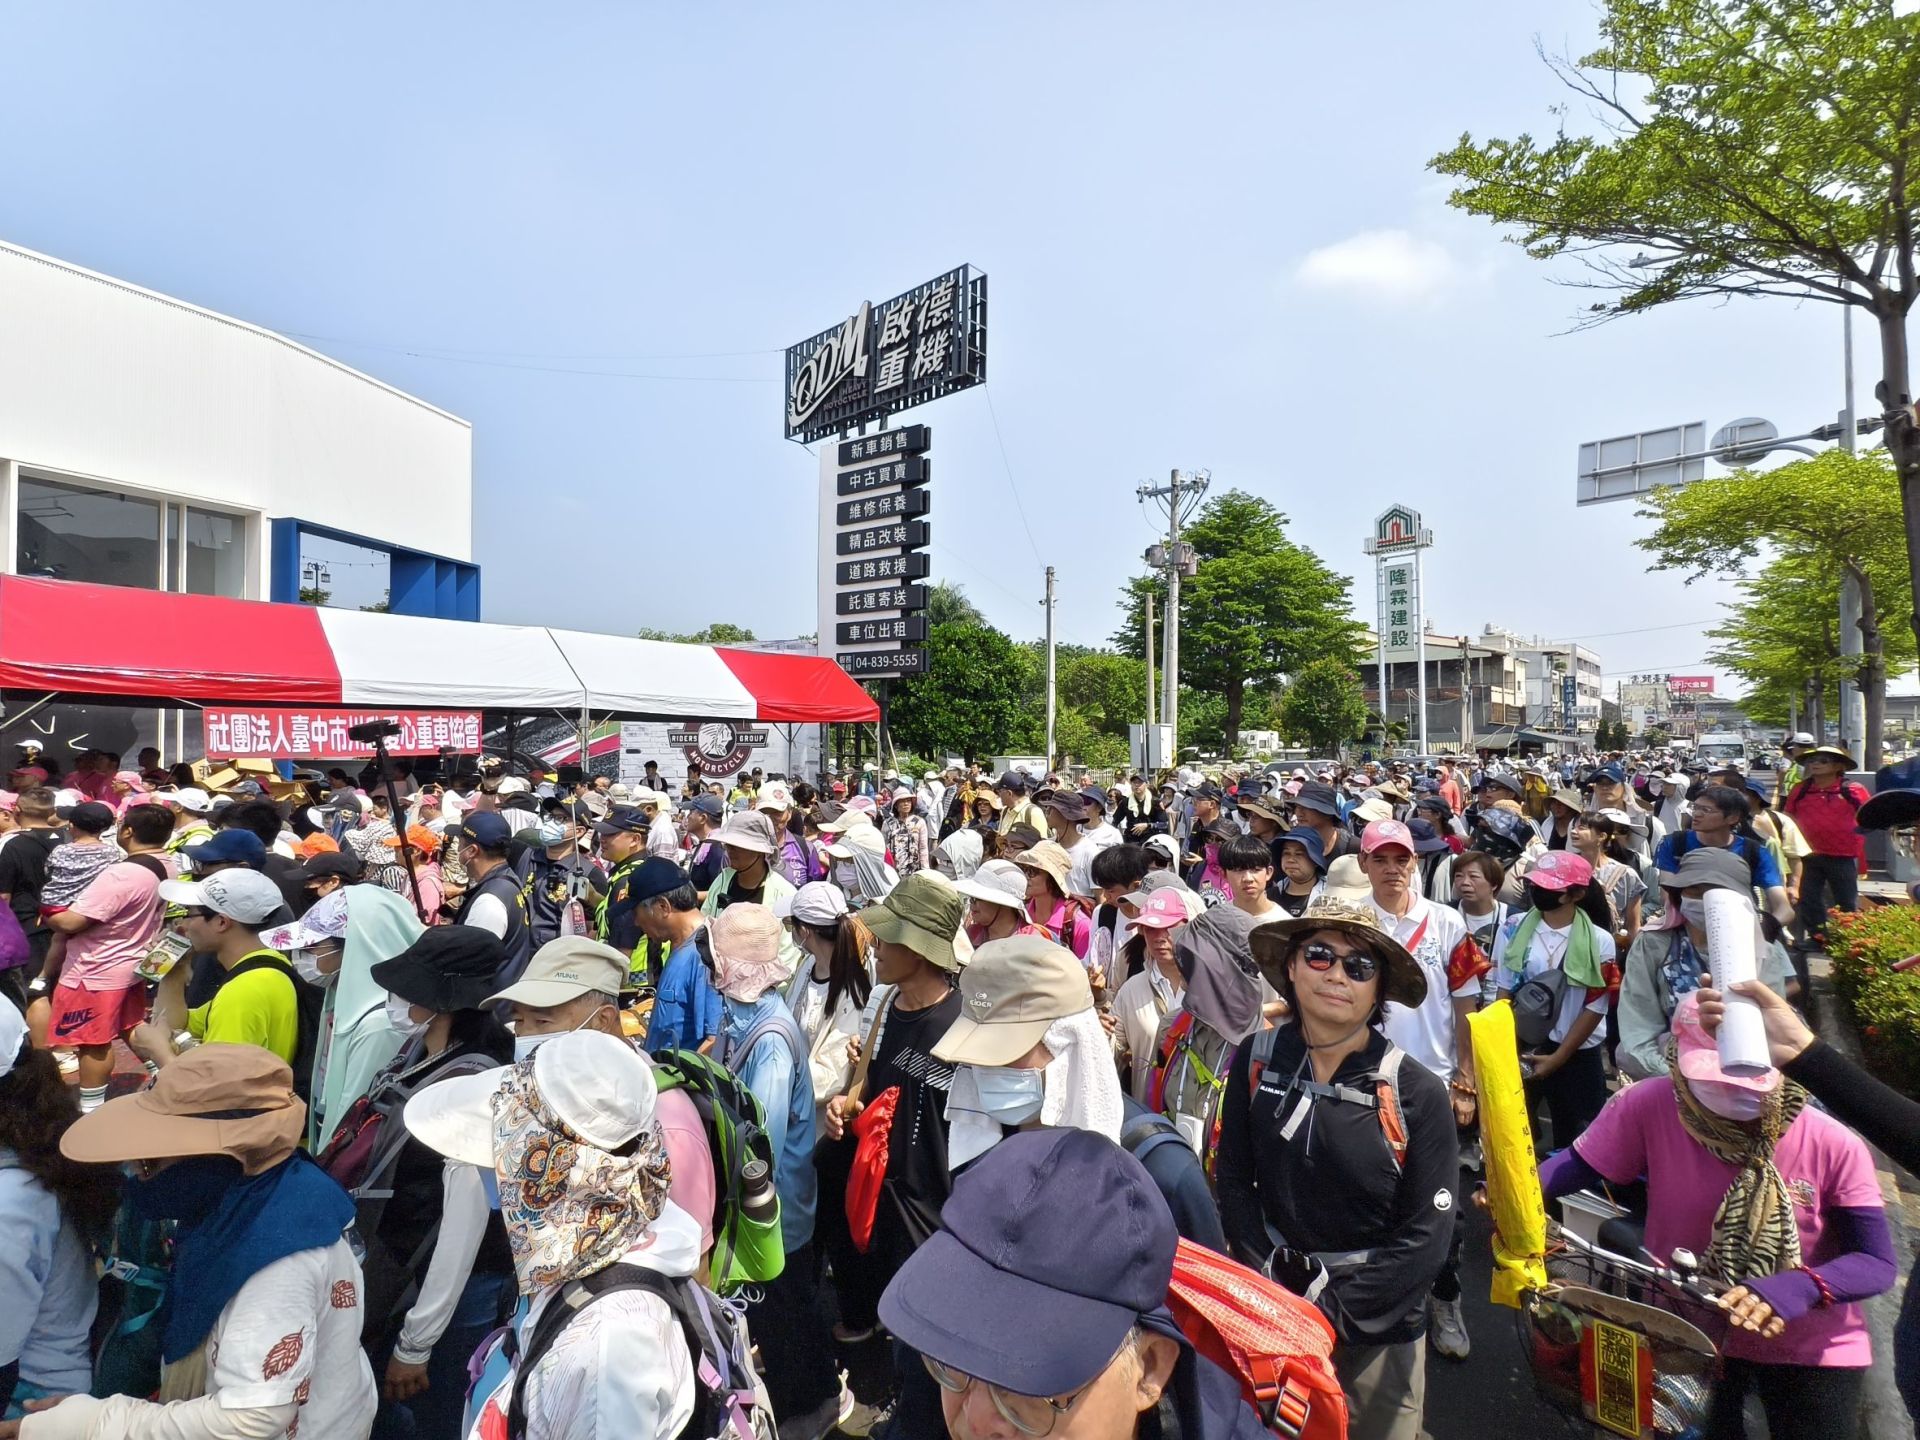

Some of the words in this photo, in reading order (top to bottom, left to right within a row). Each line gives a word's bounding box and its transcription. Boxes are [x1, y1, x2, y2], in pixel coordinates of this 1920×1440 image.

[878, 279, 956, 349] 啟德
[874, 329, 951, 394] 重機
[842, 381, 867, 395] HEAVY
[851, 432, 907, 458] 新車銷售
[849, 463, 906, 488] 中古買賣
[849, 495, 907, 519] 維修保養
[849, 526, 907, 550] 精品改裝
[849, 558, 907, 580] 道路救援
[848, 590, 907, 610] 託運寄送
[1389, 569, 1409, 647] 隆霖建設
[848, 621, 906, 640] 車位出租
[856, 653, 918, 669] 04-839-5555
[690, 750, 744, 773] MOTORCYCLE
[61, 1008, 93, 1025] NIKE
